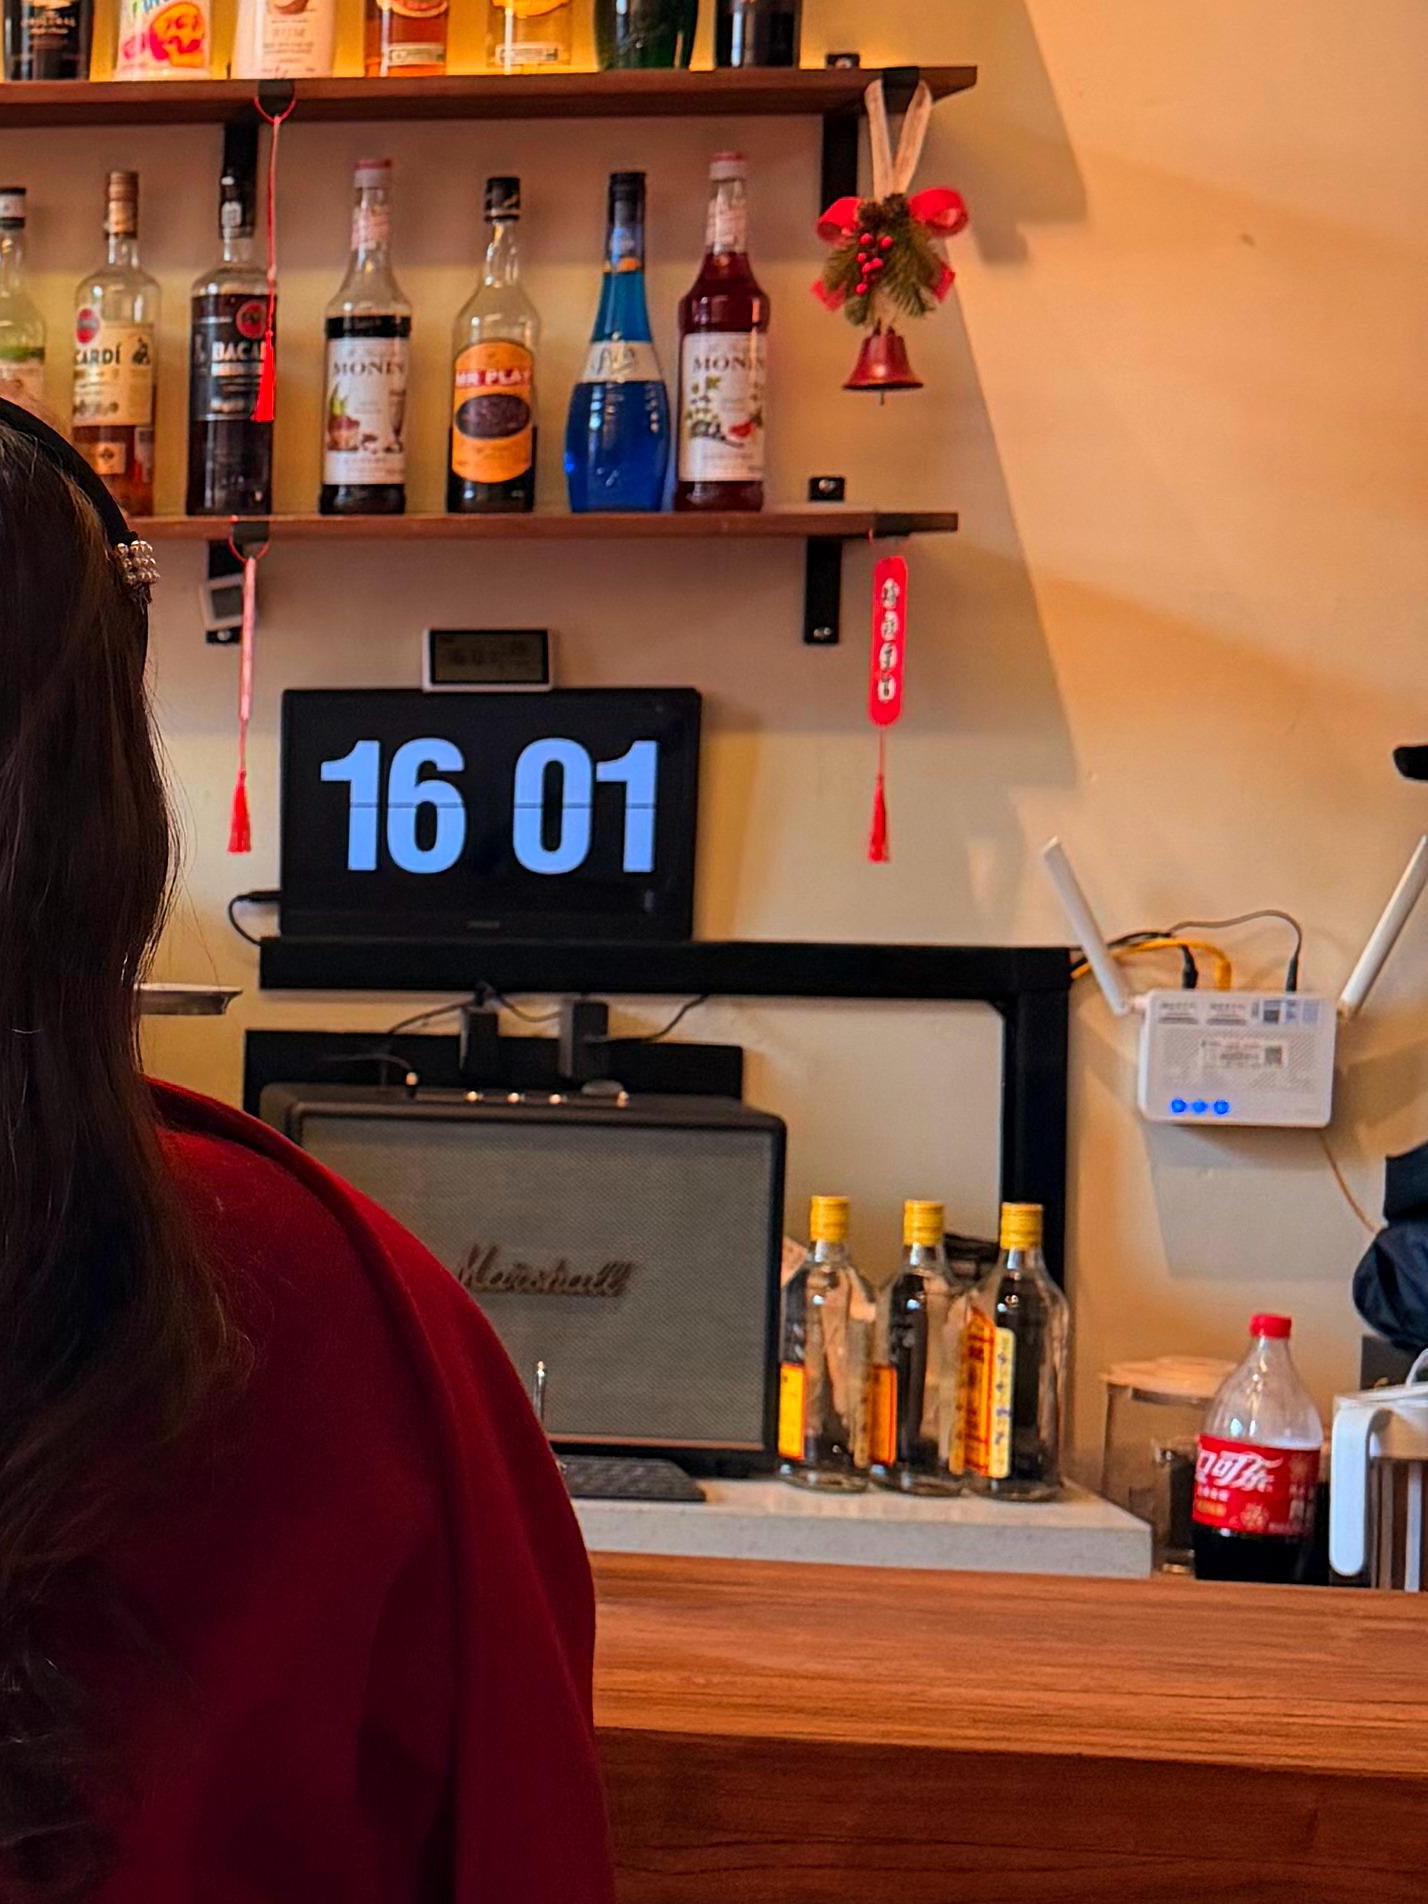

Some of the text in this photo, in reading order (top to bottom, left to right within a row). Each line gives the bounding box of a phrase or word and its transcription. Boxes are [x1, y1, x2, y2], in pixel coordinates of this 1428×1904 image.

[320, 736, 659, 876] 16 01
[457, 1243, 636, 1297] Marshall
